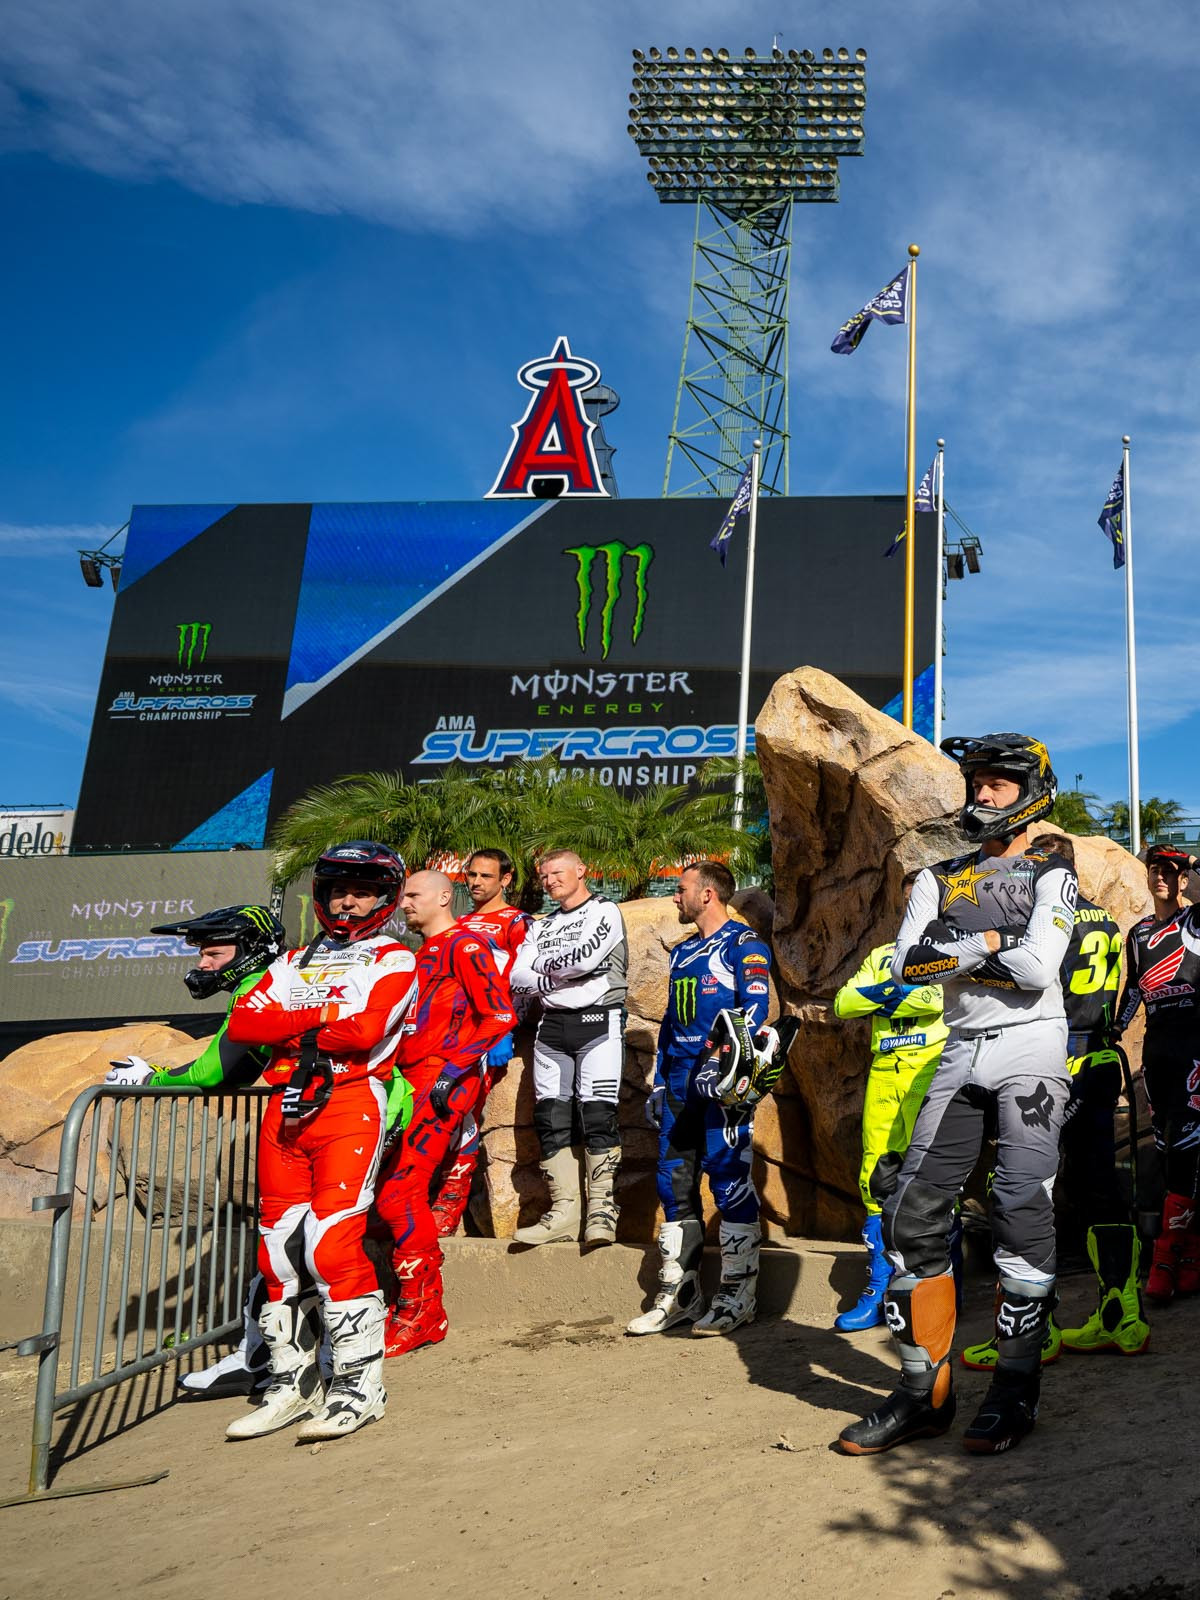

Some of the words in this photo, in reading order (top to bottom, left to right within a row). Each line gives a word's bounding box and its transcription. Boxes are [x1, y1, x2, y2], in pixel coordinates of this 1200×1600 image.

[149, 673, 223, 687] MONSTER
[510, 669, 694, 699] MONSTER
[108, 695, 257, 711] SUPERCROSS
[119, 691, 135, 699] AMA
[139, 711, 222, 721] CHAMPIONSHIP
[538, 703, 664, 716] ENERGY
[435, 716, 476, 730] AMA
[71, 899, 195, 920] MONSTER
[542, 916, 612, 974] FASTHOUSE
[904, 955, 959, 977] ROCKSTAR
[1143, 984, 1195, 1002] HONDA
[889, 1034, 924, 1047] YAMAHA
[279, 1087, 302, 1113] FLY
